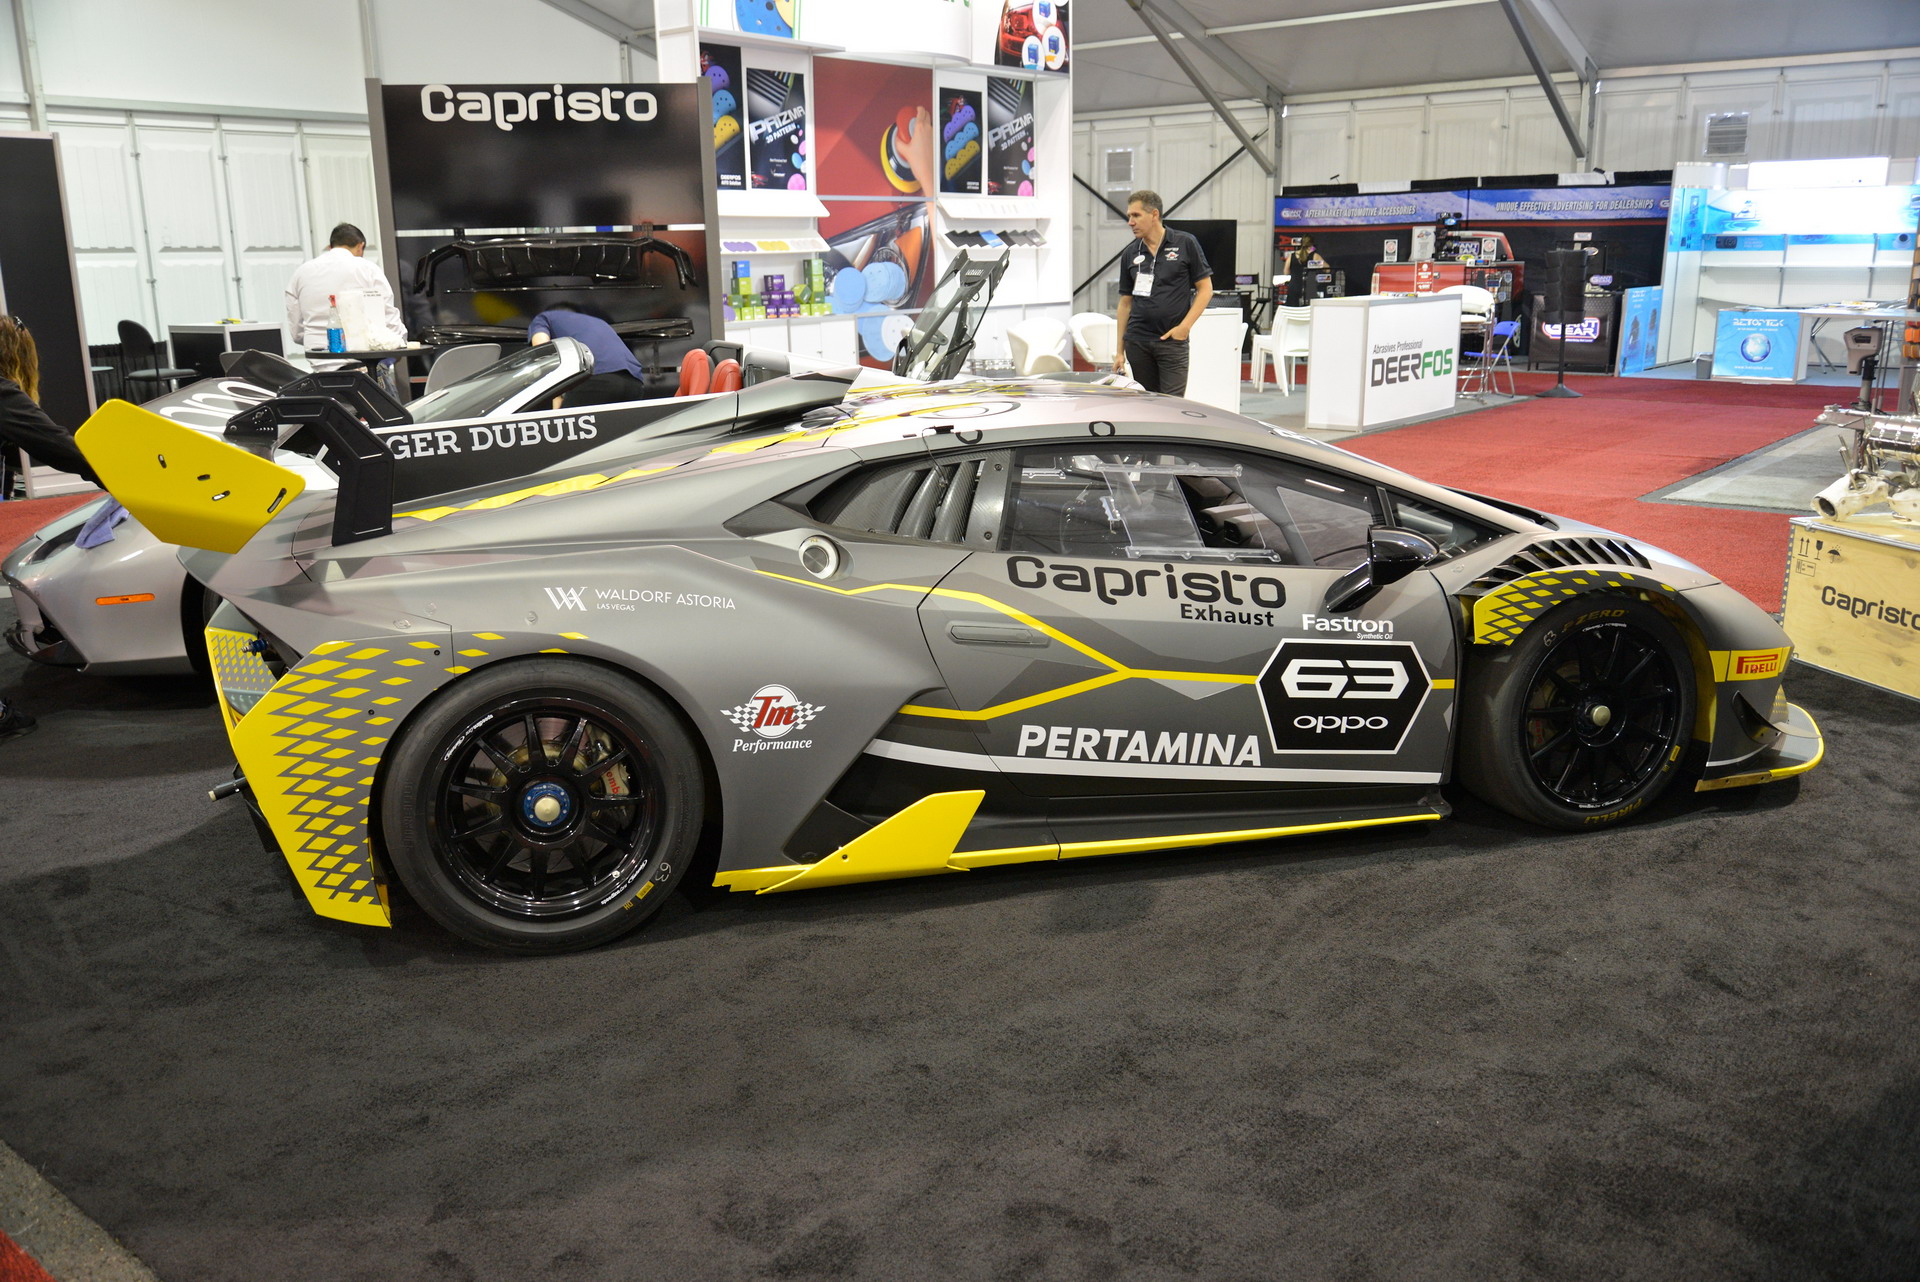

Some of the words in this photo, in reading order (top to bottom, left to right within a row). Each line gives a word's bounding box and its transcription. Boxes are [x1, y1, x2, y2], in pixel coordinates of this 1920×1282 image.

[420, 83, 658, 131] Capristo
[1304, 208, 1343, 218] AFTERMARKET
[1343, 207, 1377, 217] AUTOMOTIVE
[1378, 205, 1416, 216] ACCESSORIES
[1495, 201, 1519, 212] UNIQUE
[1519, 200, 1551, 211] EFFECTIVE
[1552, 200, 1594, 211] ADVERTISING
[1595, 200, 1609, 210] FOR
[1609, 199, 1654, 210] DEALERSHIPS
[1373, 343, 1397, 354] Abrasives
[1396, 339, 1424, 351] Professional
[1370, 348, 1453, 387] DEERFOS
[386, 430, 462, 460] GER
[468, 415, 598, 452] DUBUIS
[1006, 555, 1287, 609] Capristo
[595, 588, 673, 603] WALDORF
[676, 593, 736, 610] ASTORIA
[1180, 603, 1275, 627] Exhaust
[1302, 613, 1394, 633] Fastron
[1356, 632, 1384, 641] Synthetic
[1736, 653, 1779, 674] PIRELLI
[1280, 658, 1410, 700] 63
[1293, 715, 1389, 734] oppo
[732, 738, 813, 754] Performance
[1016, 724, 1262, 767] PERTAMINA
[1584, 798, 1643, 824] PIRELLI
